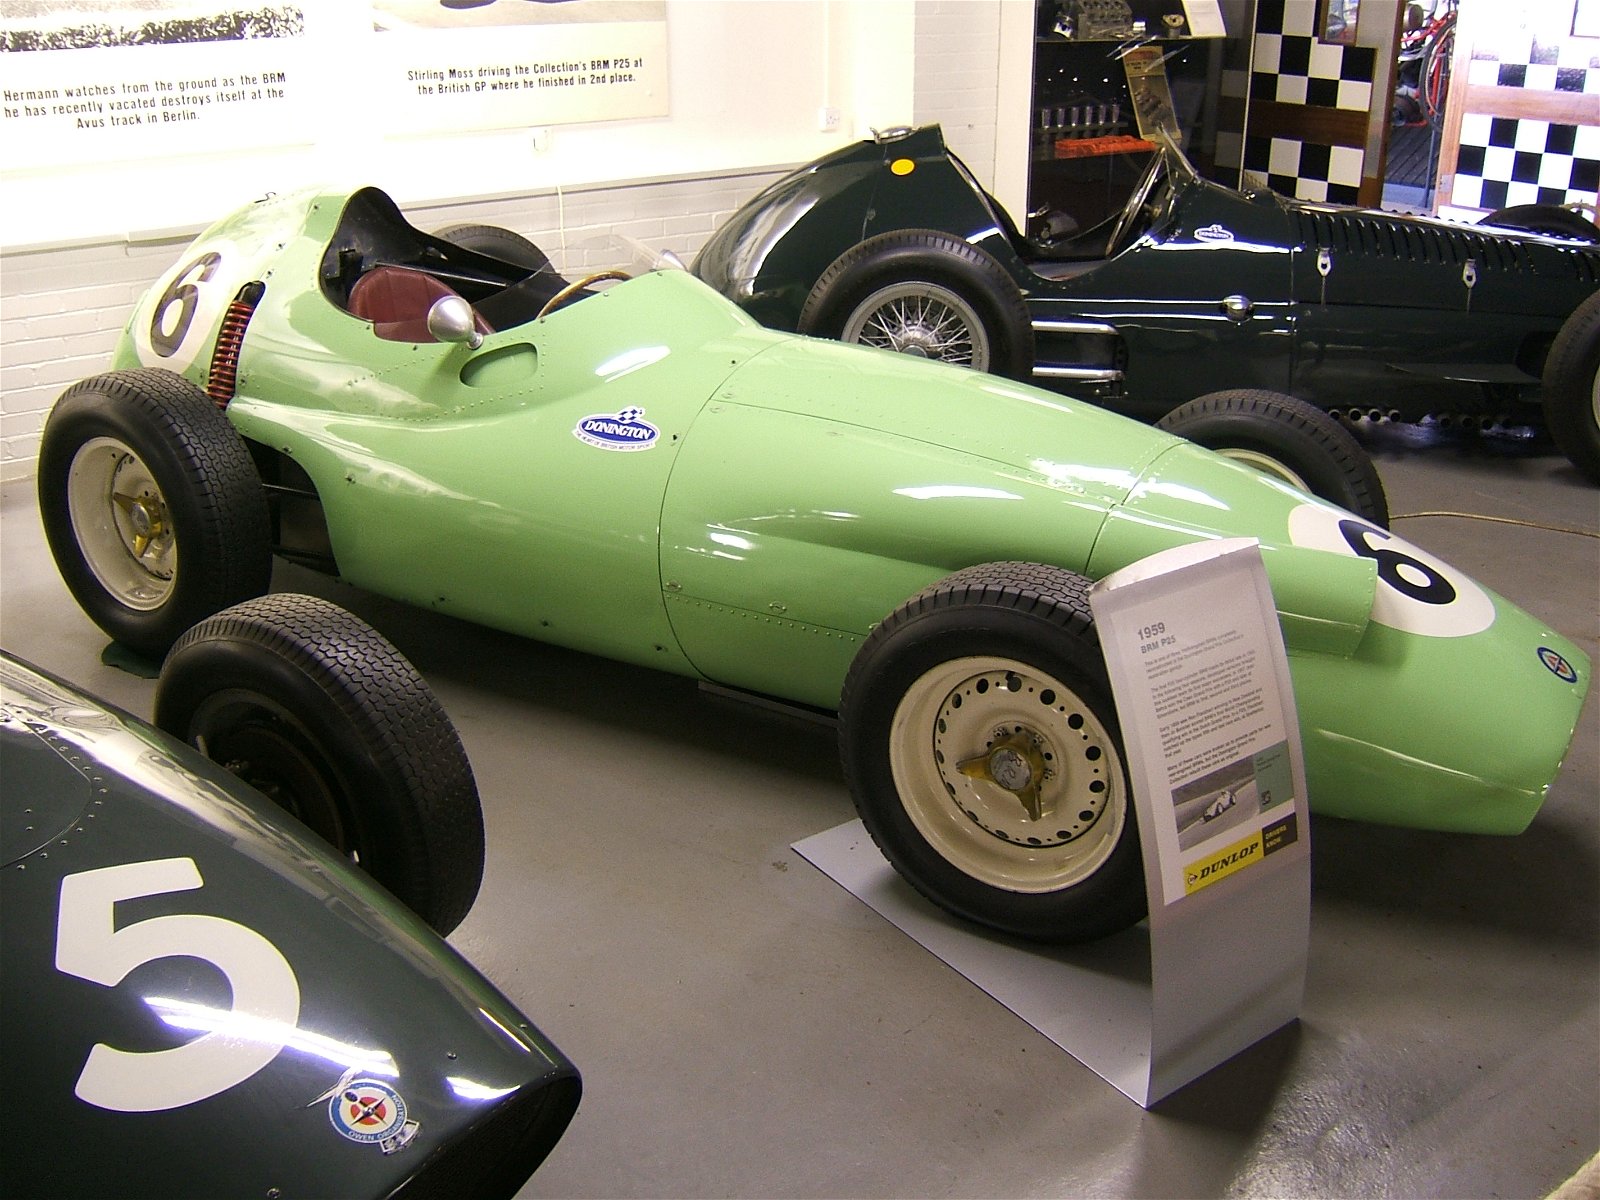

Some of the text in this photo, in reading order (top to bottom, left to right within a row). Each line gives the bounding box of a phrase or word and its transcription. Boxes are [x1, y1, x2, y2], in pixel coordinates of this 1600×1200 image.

[408, 58, 642, 81] Stirling Moss driving the Collection's BRM P25 at
[4, 72, 286, 101] Hermann watches from the ground as the BRM
[418, 72, 636, 94] the British GP where he finished in 2nd place.
[4, 88, 284, 118] he has recently vacated destroys itself at the
[77, 110, 200, 129] Avus track in Berlin.
[151, 252, 222, 358] 6
[584, 420, 652, 440] DONINGTON
[1338, 519, 1457, 605] 6
[1137, 622, 1166, 640] 1959
[1140, 636, 1176, 654] BRM P25
[1200, 842, 1259, 880] DUNLOP
[55, 857, 300, 1112] 5
[348, 1130, 374, 1141] OWEN
